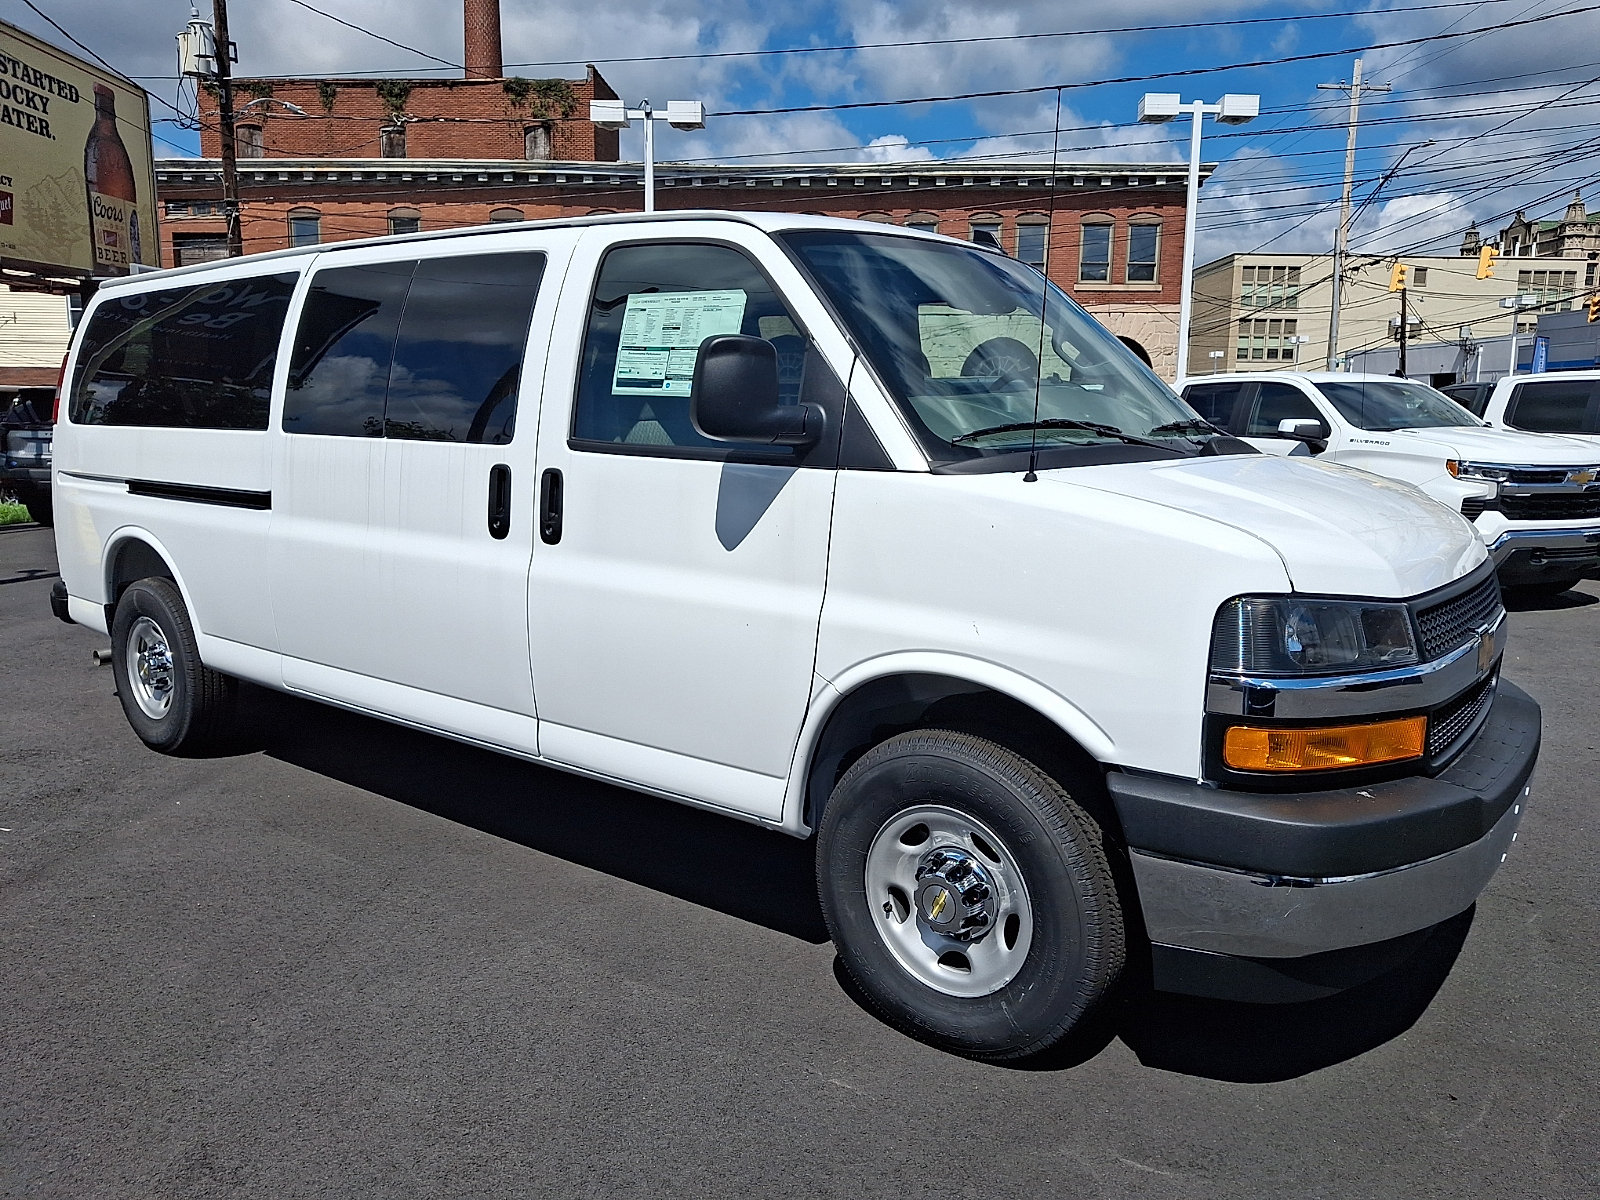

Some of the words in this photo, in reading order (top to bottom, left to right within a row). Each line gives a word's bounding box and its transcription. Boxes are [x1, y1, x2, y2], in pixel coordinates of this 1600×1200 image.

[0, 53, 80, 104] STARTED
[0, 78, 50, 116] OCKY
[0, 104, 57, 141] ATER.
[93, 196, 125, 224] Coors
[97, 247, 128, 265] BEER
[1350, 438, 1391, 446] SILVERADO
